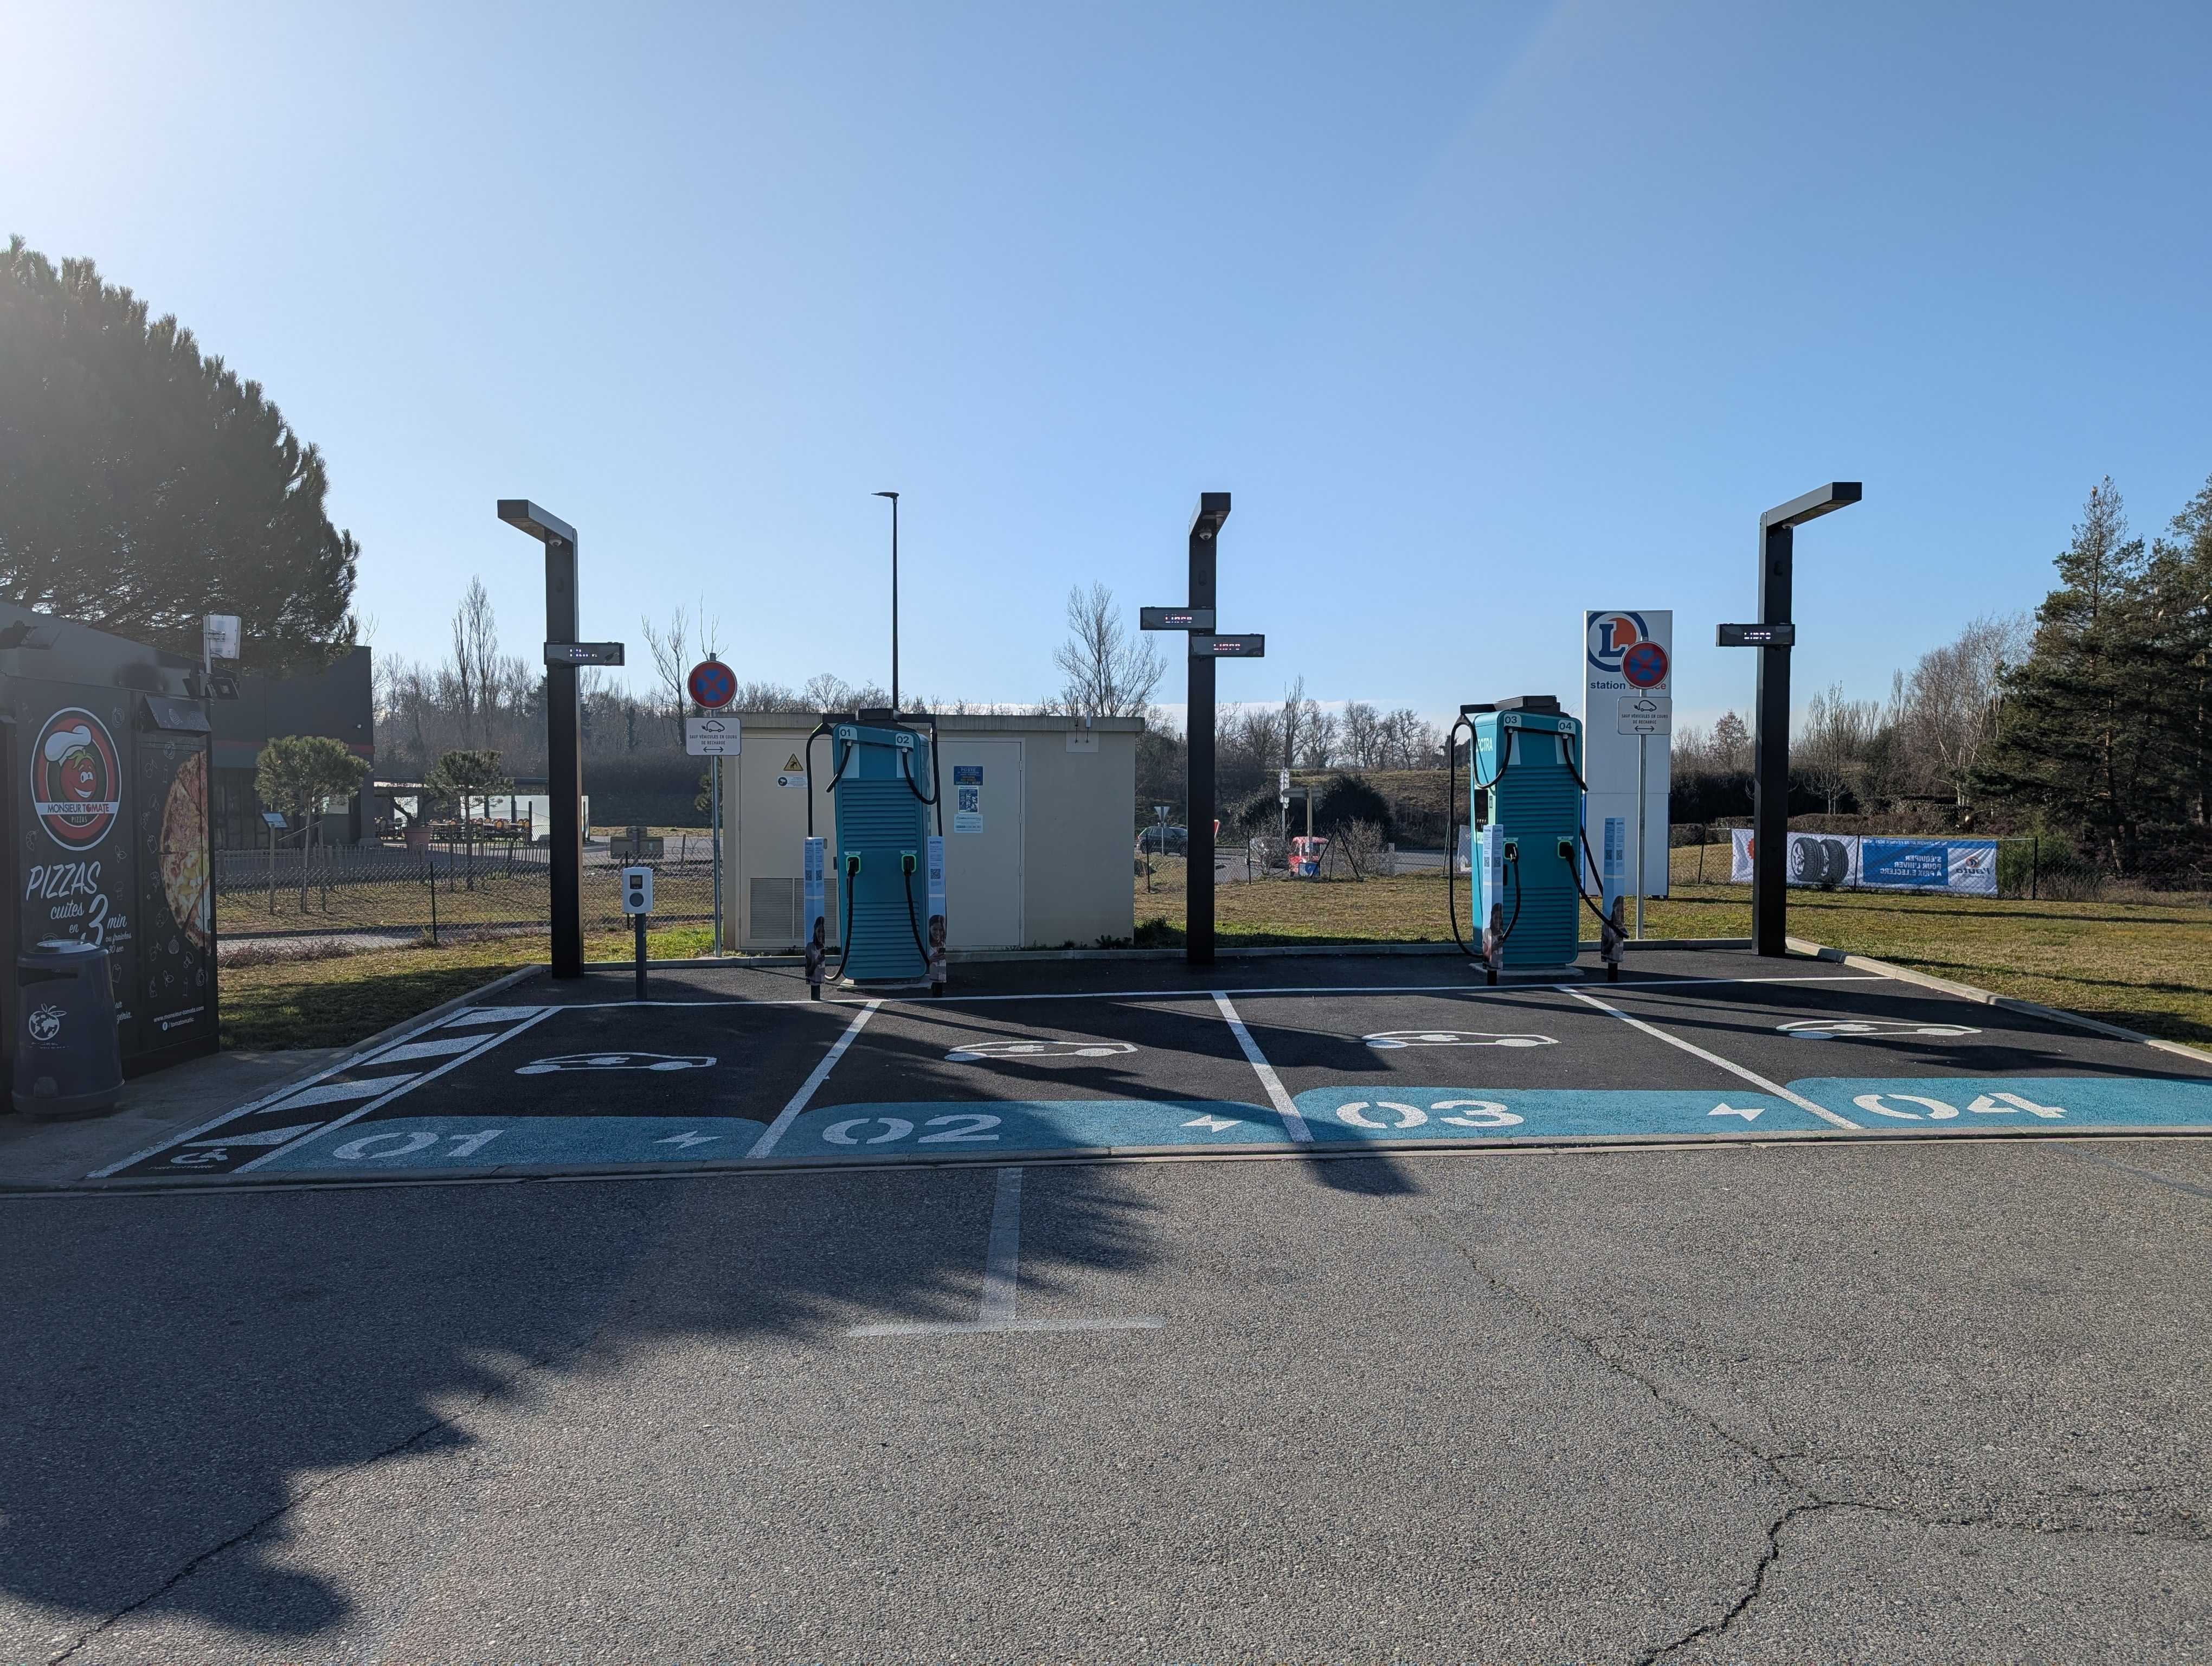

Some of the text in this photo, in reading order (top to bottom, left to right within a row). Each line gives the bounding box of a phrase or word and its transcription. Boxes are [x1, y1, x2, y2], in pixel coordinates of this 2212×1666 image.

[1599, 624, 1626, 657] L
[1590, 681, 1626, 689] station
[1504, 716, 1517, 724] 03
[1559, 722, 1572, 730] 04
[897, 736, 909, 744] 02
[47, 802, 109, 813] MONSIEUR TOMATE
[26, 861, 101, 901] PIZZAS
[50, 899, 85, 920] cuites
[69, 894, 127, 945] en 3 min
[1336, 1100, 1524, 1128] 03
[1853, 1093, 2067, 1119] 04
[822, 1114, 1002, 1144] 02
[332, 1130, 505, 1159] 01
